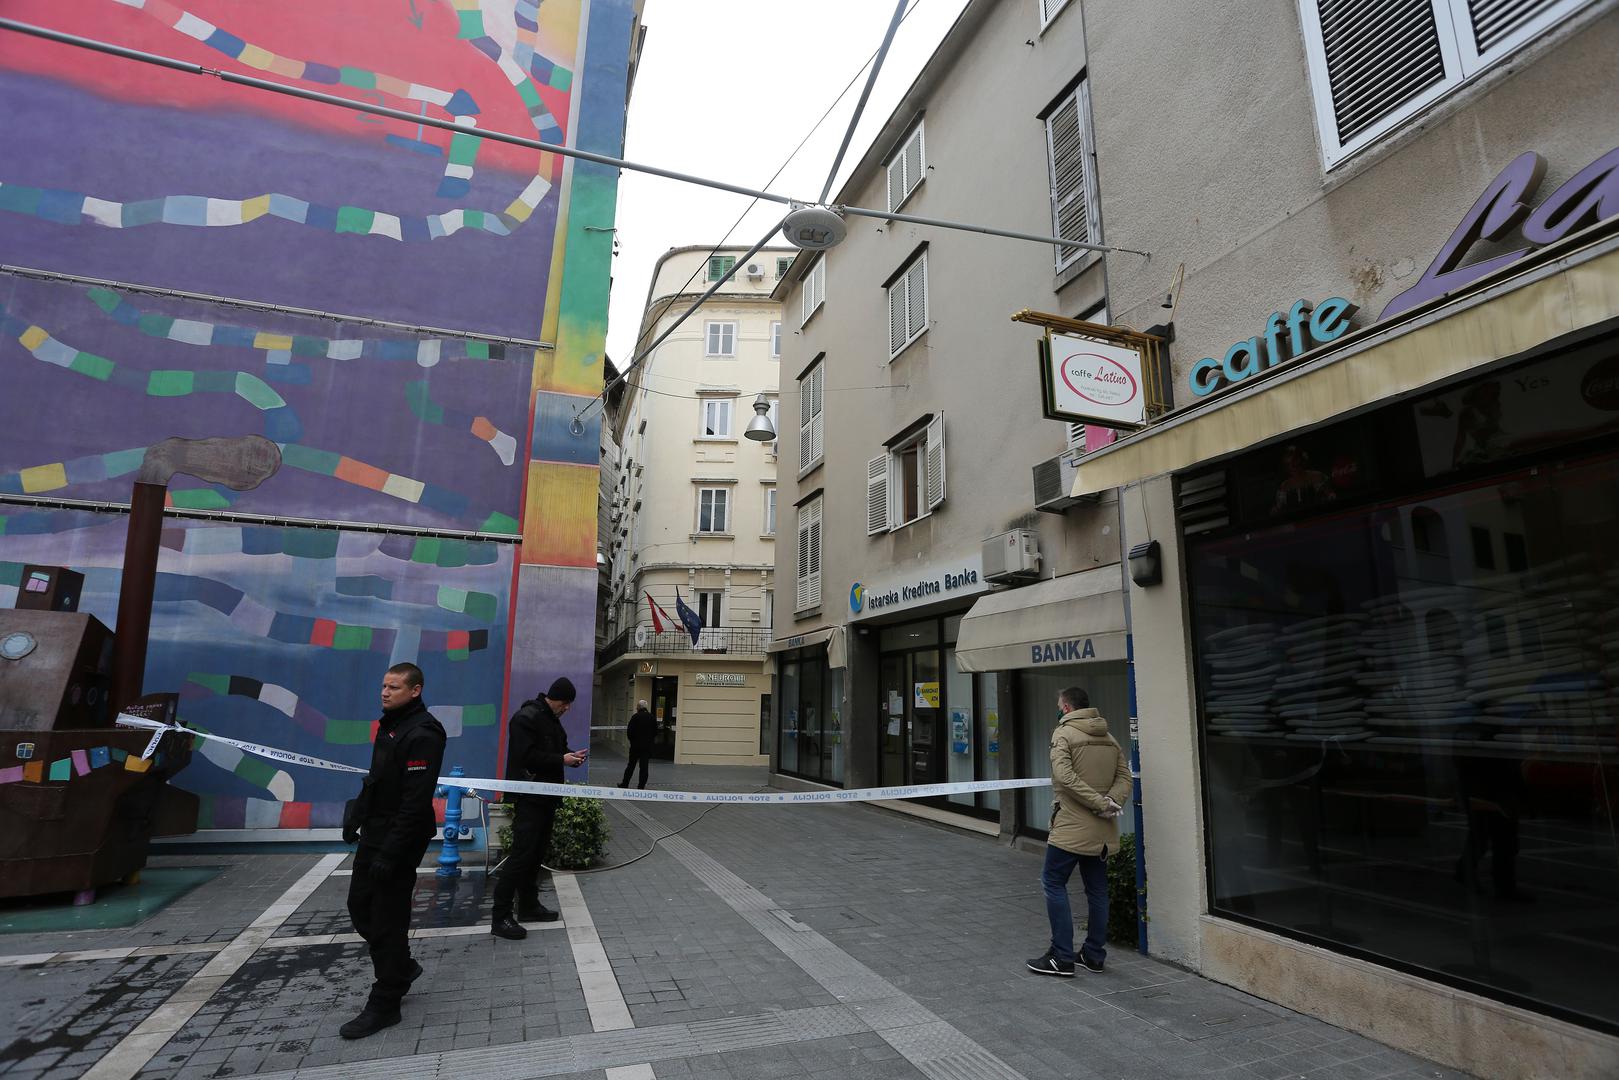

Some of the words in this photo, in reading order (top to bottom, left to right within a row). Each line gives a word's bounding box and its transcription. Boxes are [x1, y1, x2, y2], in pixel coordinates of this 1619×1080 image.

[1189, 296, 1356, 397] caffe
[1071, 369, 1092, 379] caffe
[1094, 366, 1127, 385] Latino
[868, 590, 900, 610] Istarska
[902, 578, 940, 601] Kreditna
[944, 568, 978, 590] Banka
[788, 637, 805, 648] BANKA
[1032, 639, 1095, 664] BANKA
[707, 673, 746, 682] NEUROTH
[269, 750, 296, 761] POLICIJA
[298, 757, 315, 765] STOP
